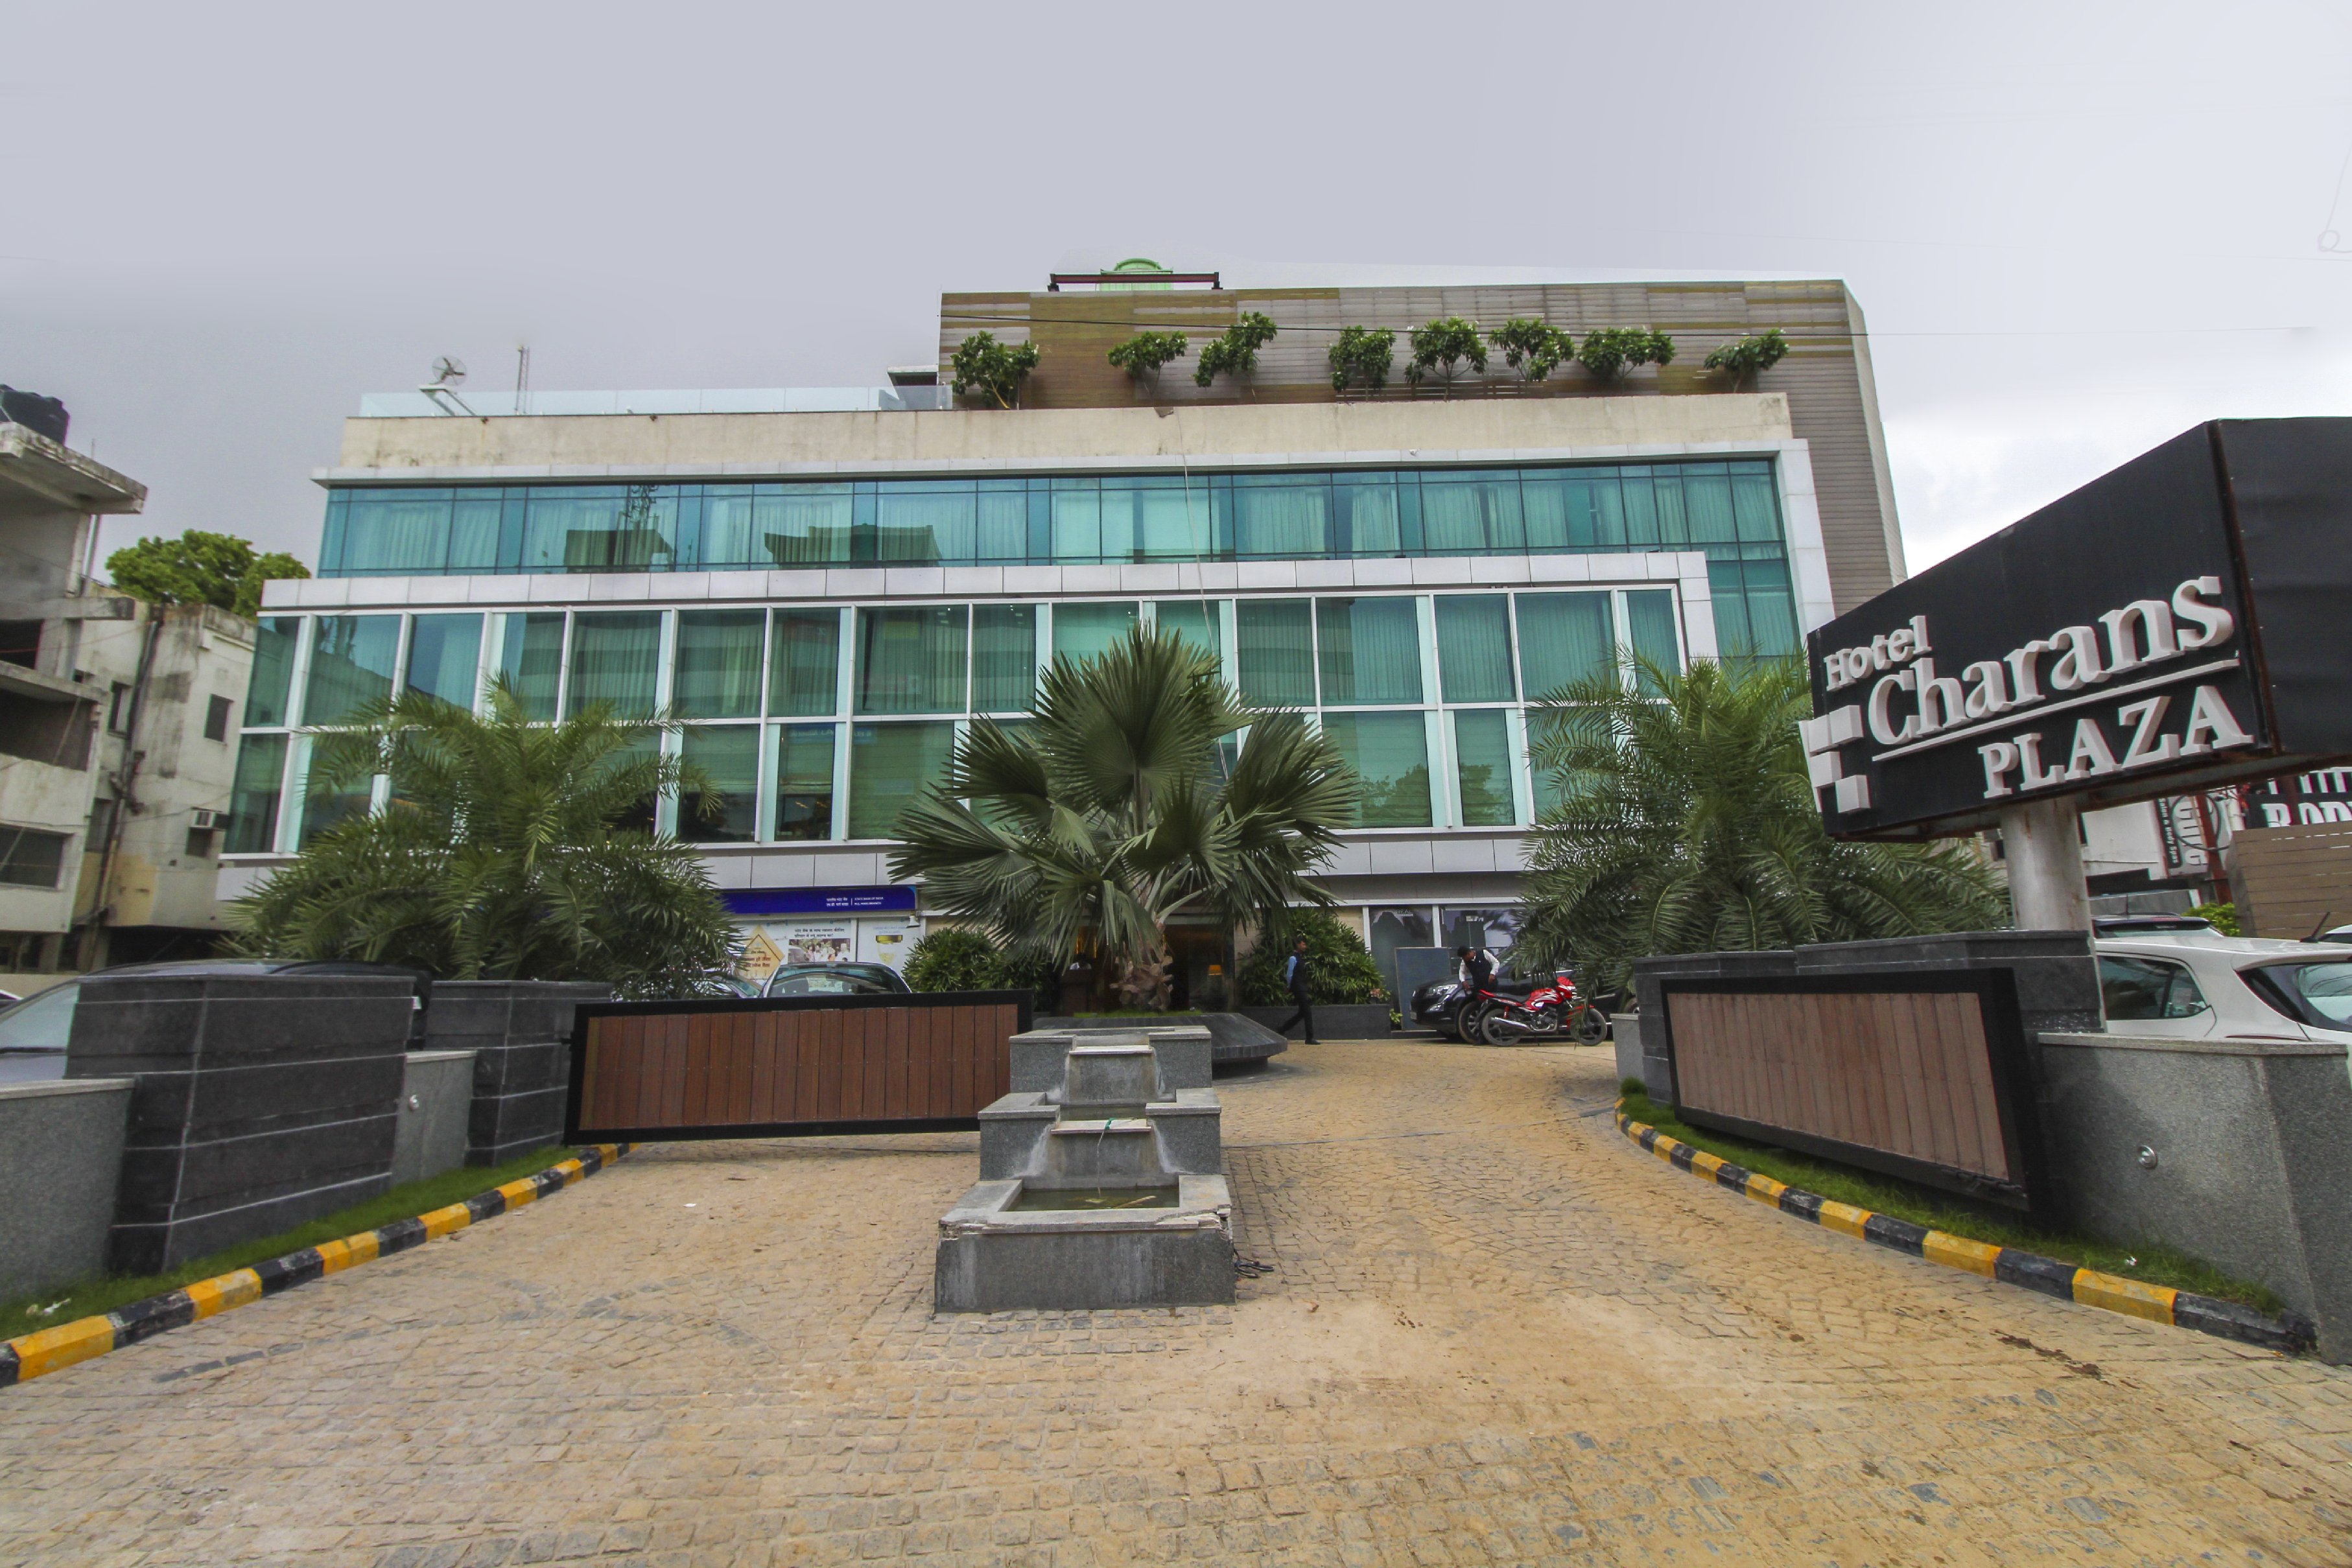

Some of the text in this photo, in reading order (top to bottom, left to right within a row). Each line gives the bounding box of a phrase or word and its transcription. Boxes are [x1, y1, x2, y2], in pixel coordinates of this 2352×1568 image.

[1824, 615, 1932, 692] Hotel
[1868, 576, 2234, 744] Charans
[1977, 685, 2254, 799] PLAZA
